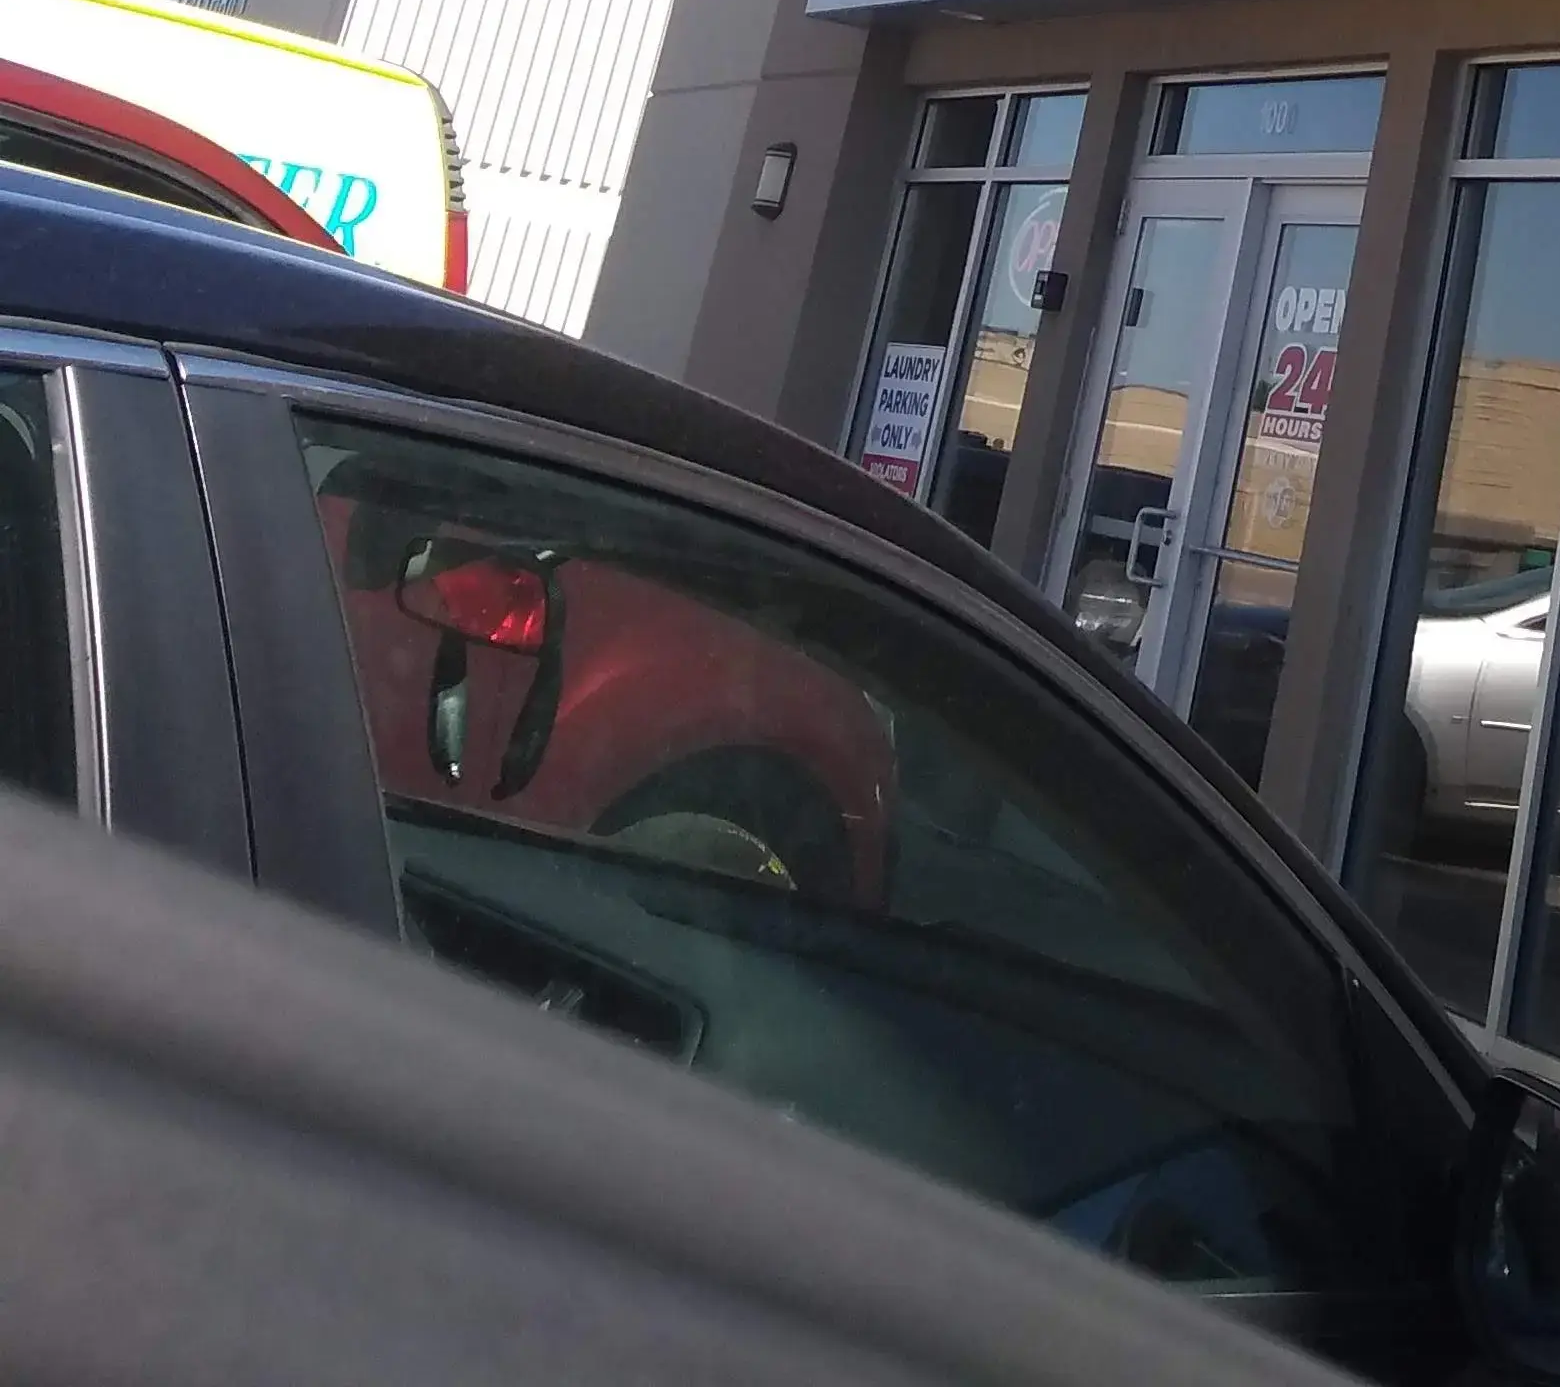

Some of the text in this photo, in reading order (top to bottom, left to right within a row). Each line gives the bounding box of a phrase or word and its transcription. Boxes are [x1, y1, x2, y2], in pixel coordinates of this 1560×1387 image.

[883, 354, 940, 383] LAUNDRY
[1265, 342, 1338, 421] 24
[878, 388, 930, 417] PARKING
[880, 423, 913, 450] ONLY
[1263, 415, 1323, 440] HOURS
